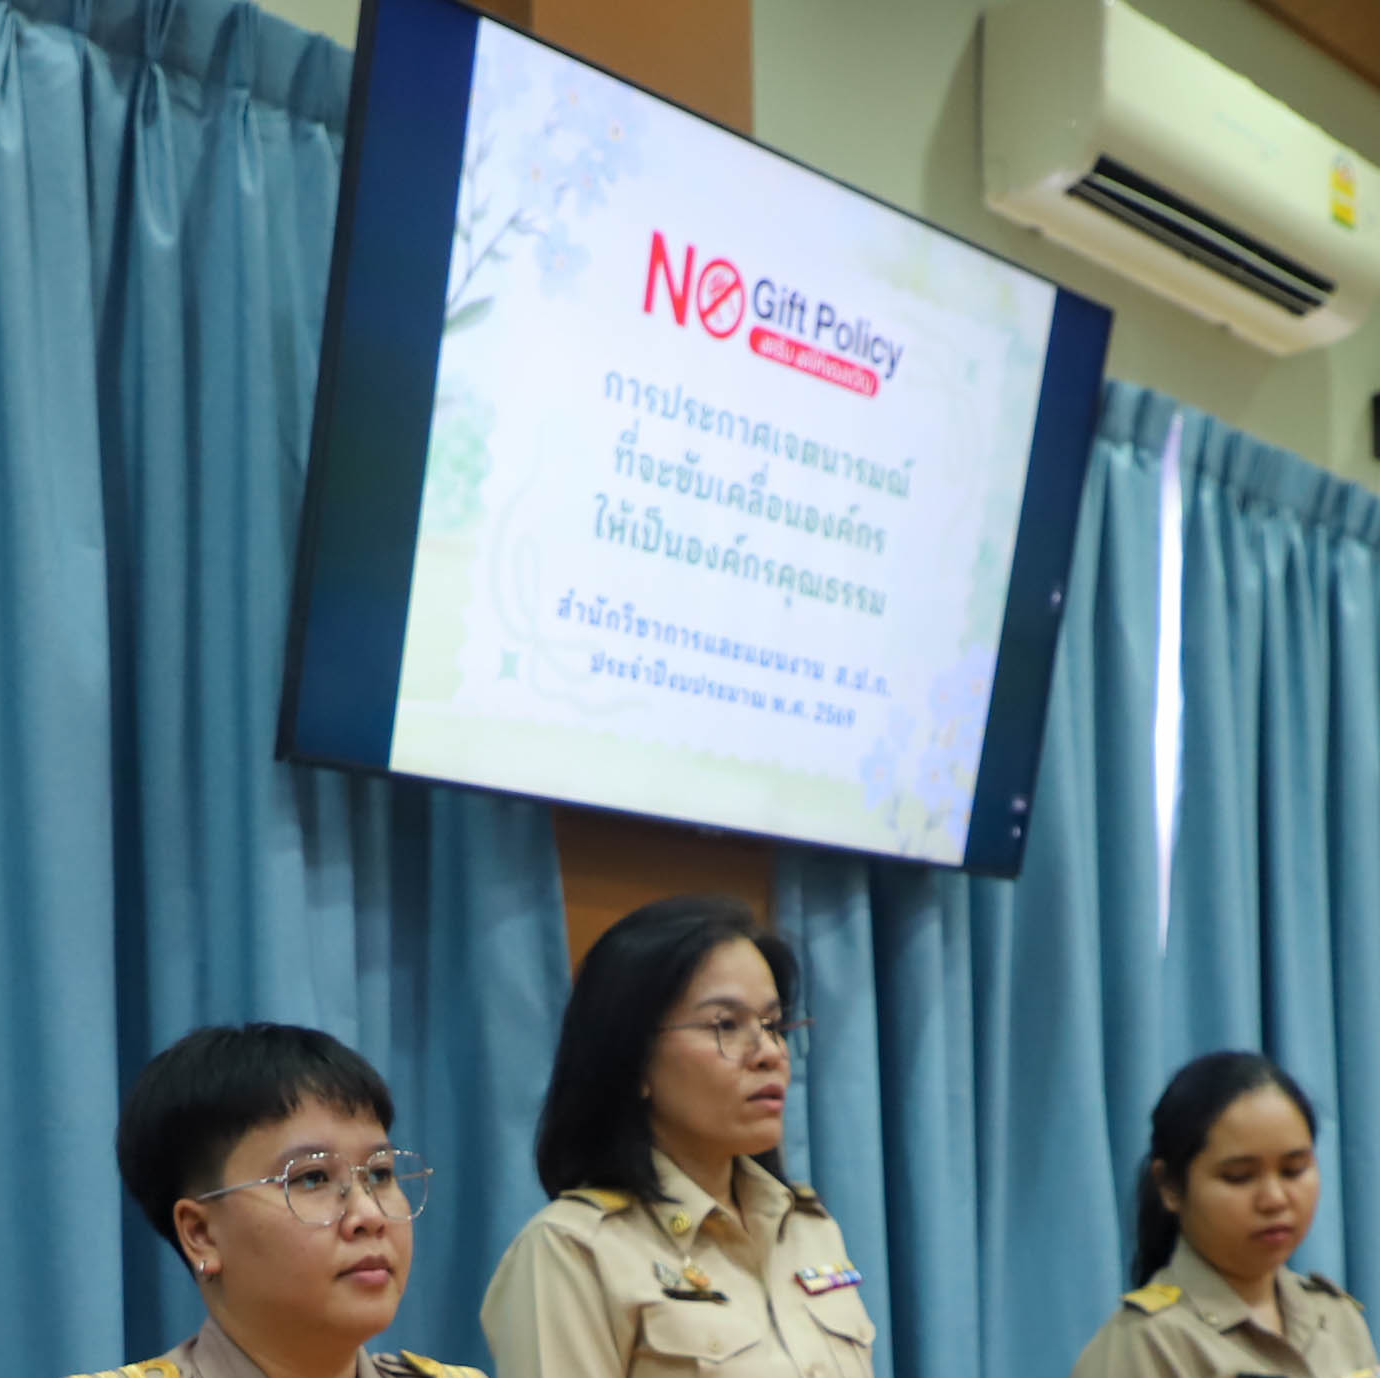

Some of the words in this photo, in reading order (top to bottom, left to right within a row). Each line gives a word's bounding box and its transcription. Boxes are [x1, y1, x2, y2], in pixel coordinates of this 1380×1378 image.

[753, 278, 808, 335] Gift
[815, 302, 904, 380] Policy
[604, 369, 916, 499] การประกาศเจตนารมณ์
[614, 418, 887, 555] ที่จะขับเคลื่อนองค์กร
[594, 491, 887, 617] ให้เป็นองค์กรคุณธรรม
[557, 587, 826, 682] สำนักวิชาการและแผนงาน
[589, 650, 767, 710] ประจำปีงบประมาณ
